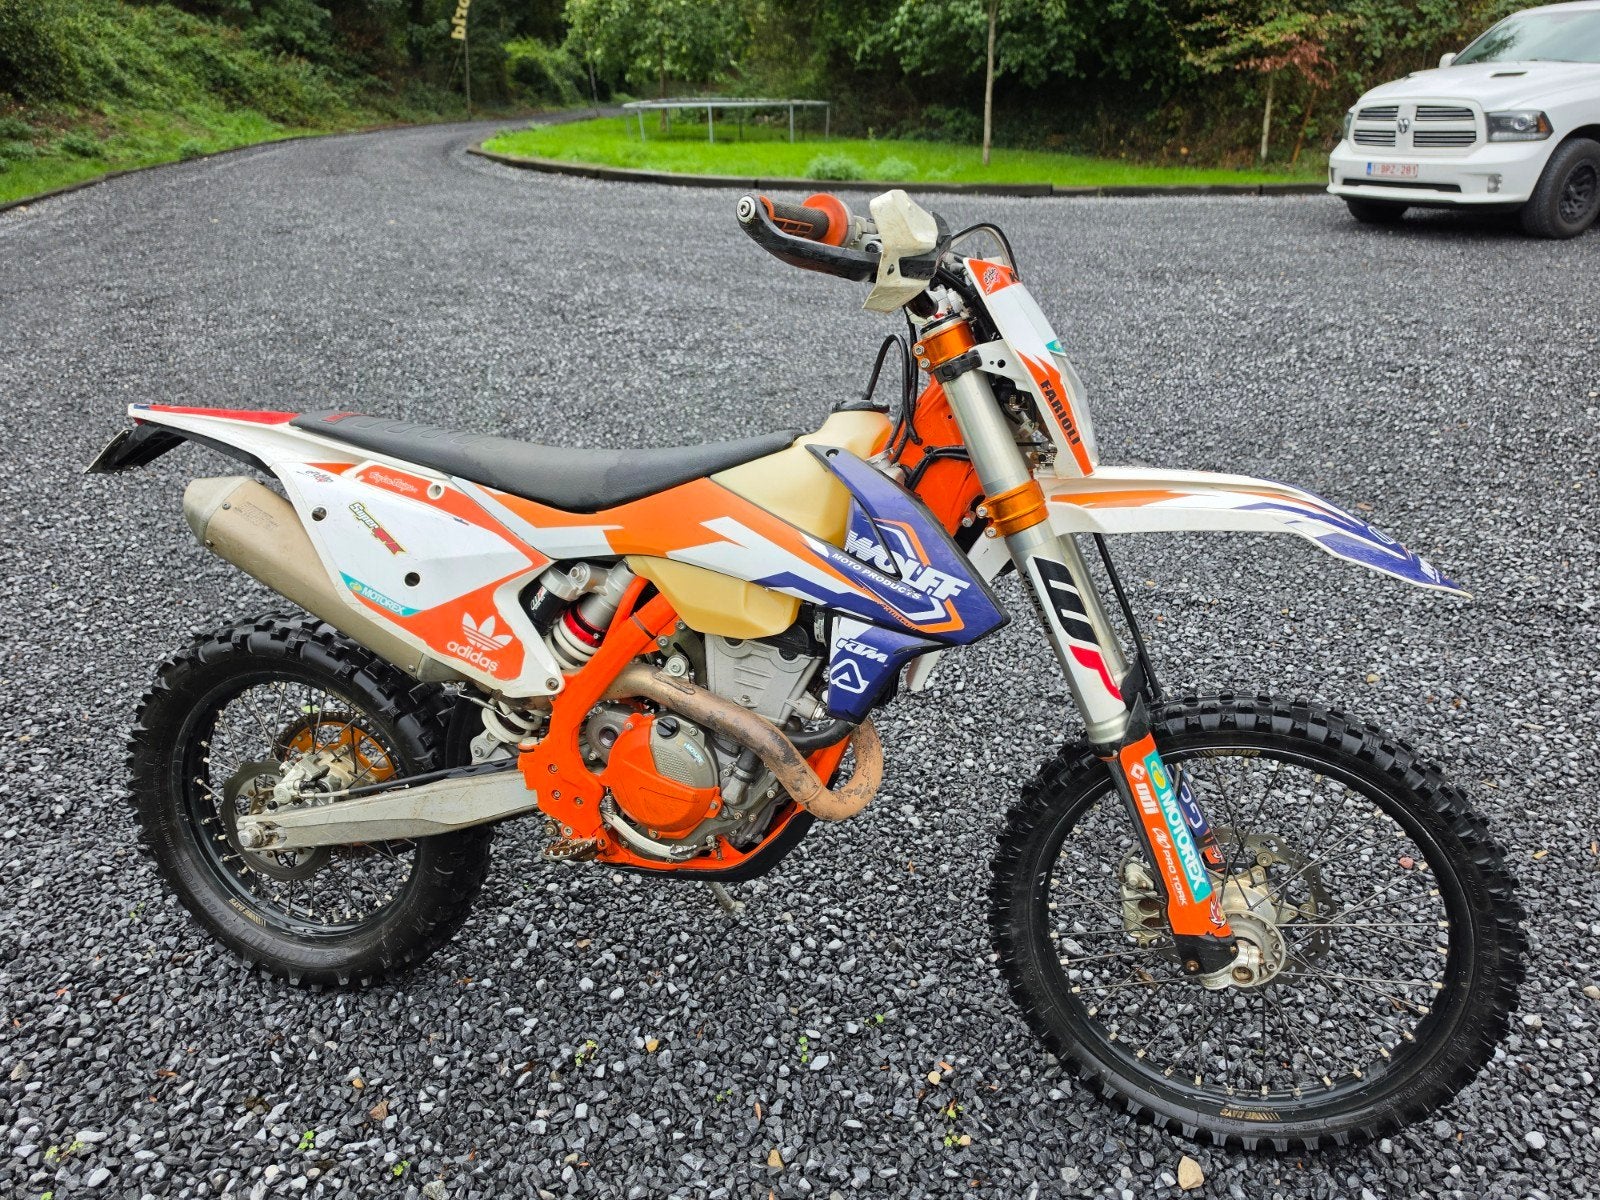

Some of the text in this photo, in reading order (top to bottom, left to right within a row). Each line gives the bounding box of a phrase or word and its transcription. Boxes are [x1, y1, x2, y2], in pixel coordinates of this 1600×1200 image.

[1040, 379, 1081, 445] FARIOLI
[831, 553, 862, 571] MOTO
[844, 530, 971, 600] WOLFF
[361, 586, 405, 615] MOTOREX
[447, 641, 499, 672] adidas
[836, 638, 888, 663] KTM
[1160, 789, 1208, 891] MOTOREX
[1163, 849, 1177, 874] PRO
[1172, 873, 1188, 906] TORK
